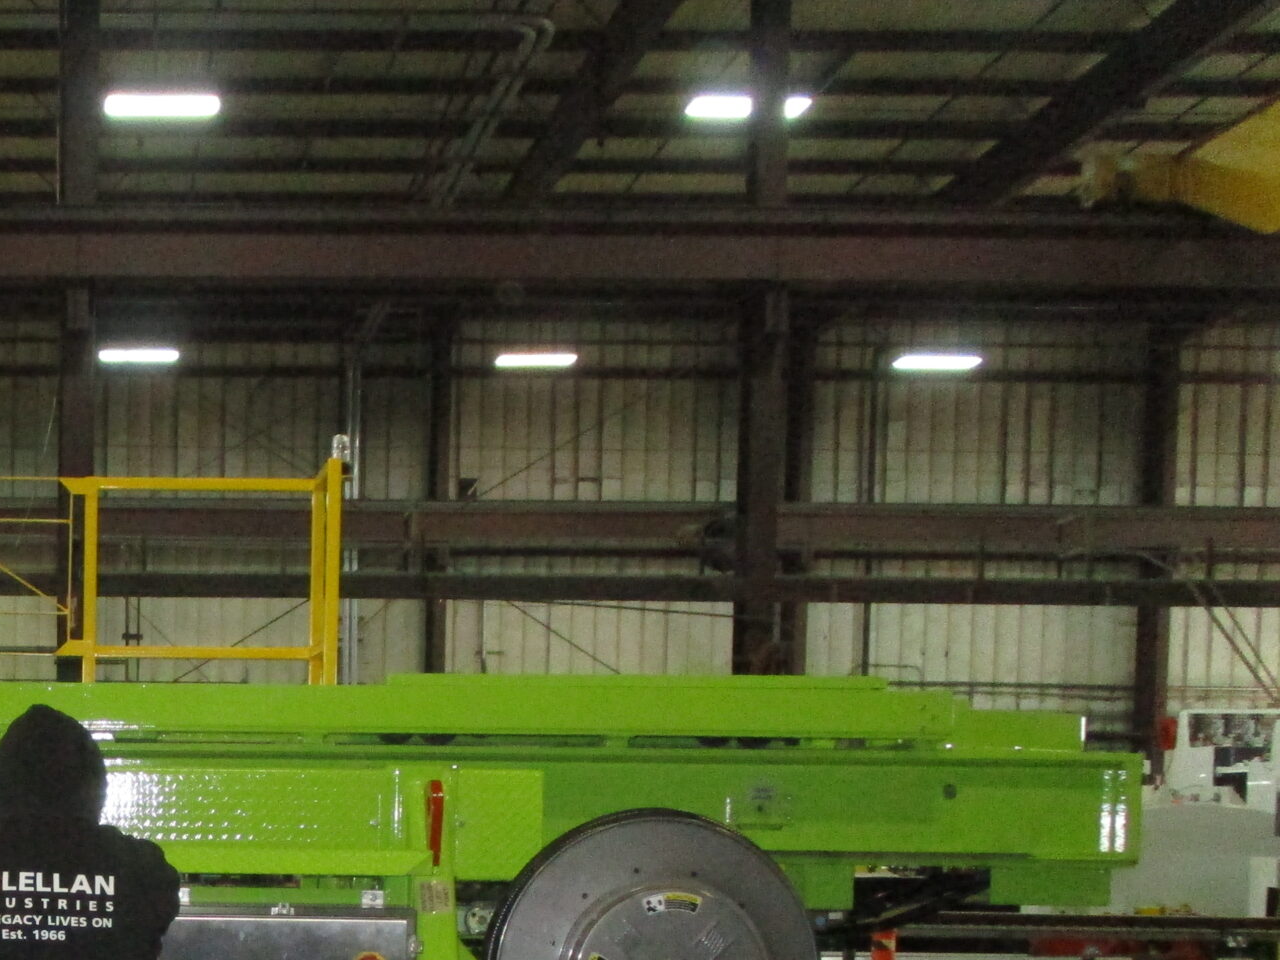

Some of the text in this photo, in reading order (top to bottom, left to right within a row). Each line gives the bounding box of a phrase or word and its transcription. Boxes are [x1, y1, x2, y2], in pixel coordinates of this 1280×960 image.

[47, 915, 87, 927] LIVES
[92, 917, 112, 928] ON
[2, 929, 66, 941] Est. 1966
